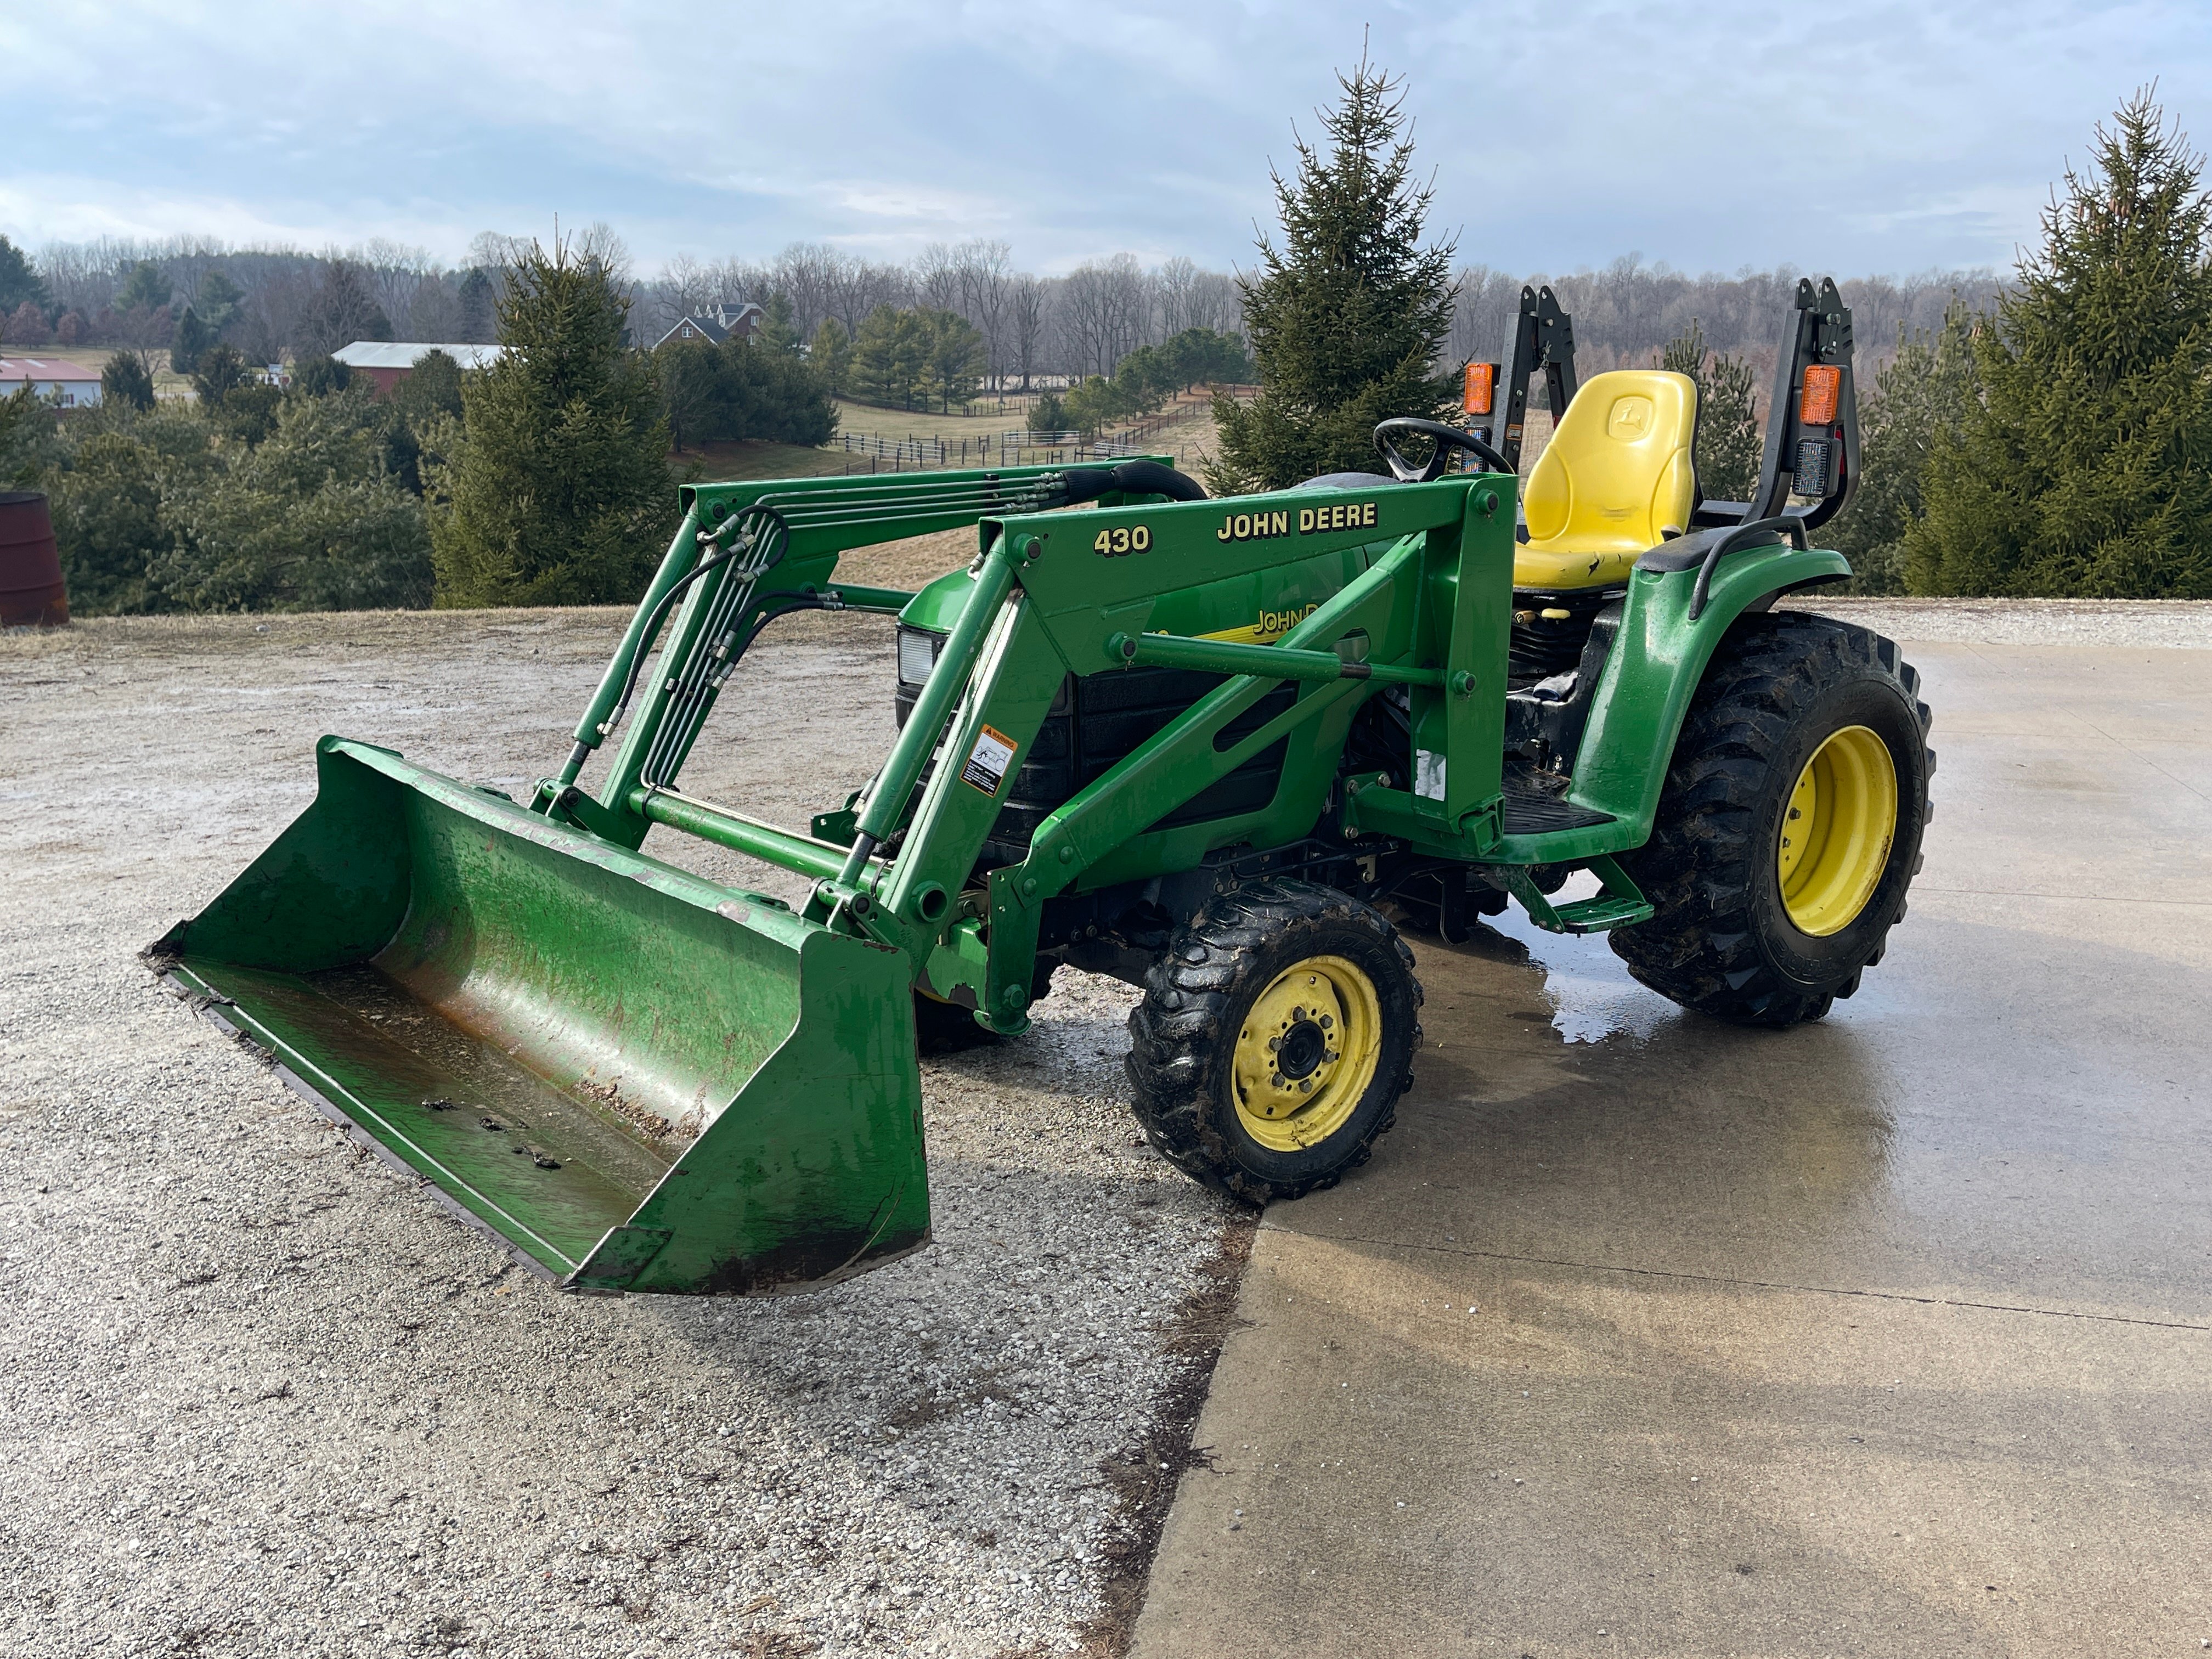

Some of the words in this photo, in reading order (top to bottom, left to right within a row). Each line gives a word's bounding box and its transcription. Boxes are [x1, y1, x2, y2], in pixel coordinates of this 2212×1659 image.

[1217, 511, 1288, 541] JOHN
[1299, 503, 1376, 532] DEERE
[1094, 525, 1151, 555] 430
[1254, 609, 1302, 634] JOHN
[992, 731, 1014, 748] WARNING
[1899, 713, 1923, 834] TITAN
